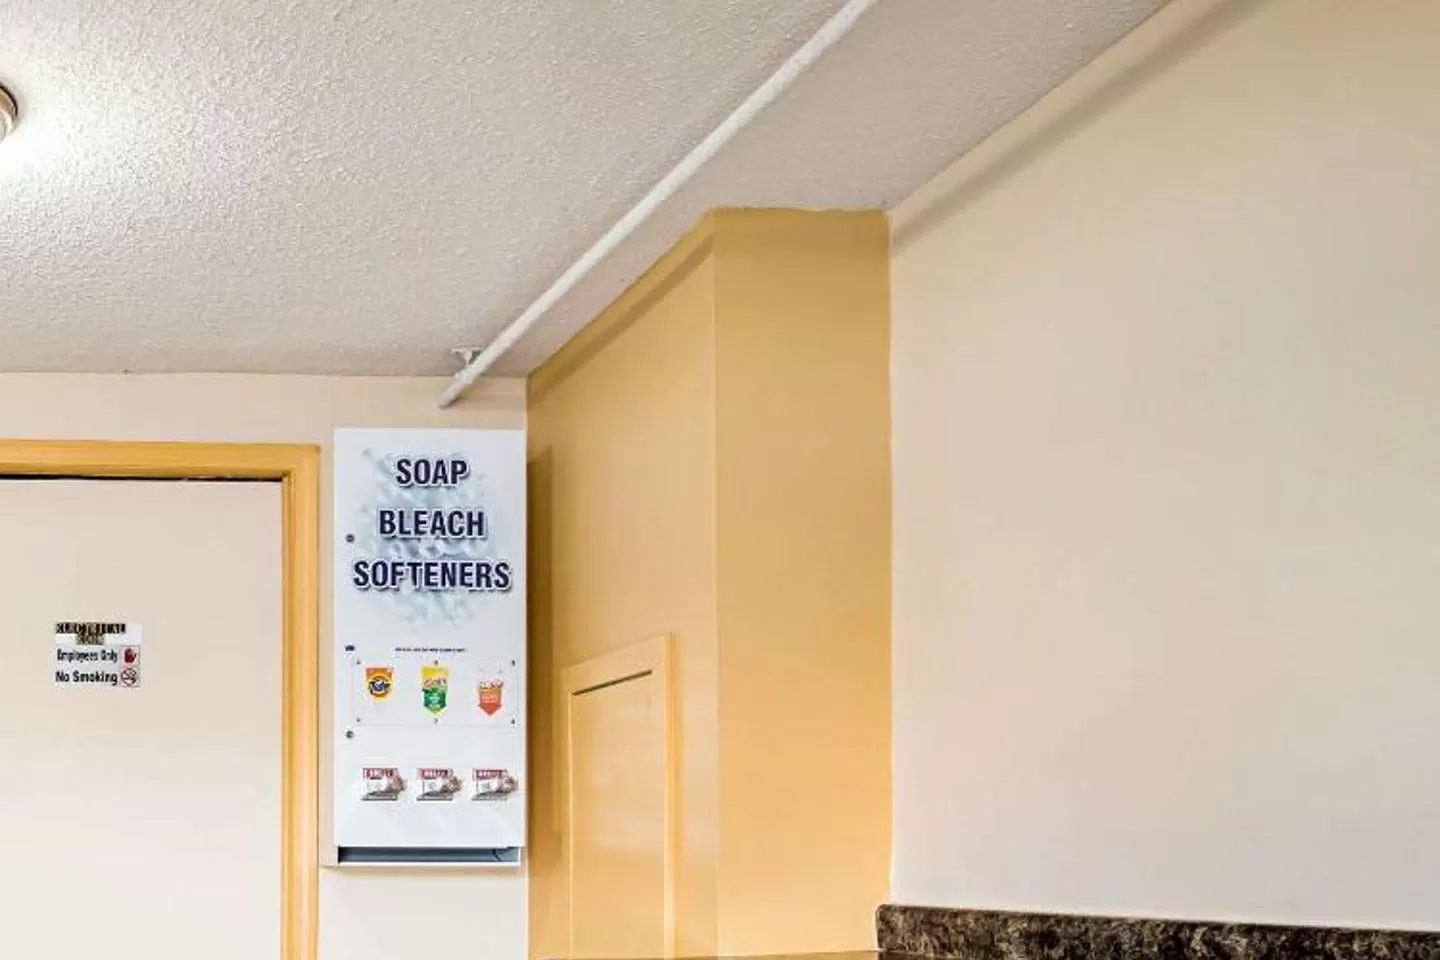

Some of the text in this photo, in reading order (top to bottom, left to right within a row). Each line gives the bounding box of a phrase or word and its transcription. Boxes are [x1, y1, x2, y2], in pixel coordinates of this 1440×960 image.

[396, 458, 469, 486] SOAP
[379, 509, 485, 537] BLEACH
[353, 560, 511, 589] SOFTENERS
[57, 648, 99, 663] Employees
[55, 669, 118, 686] No Smoking
